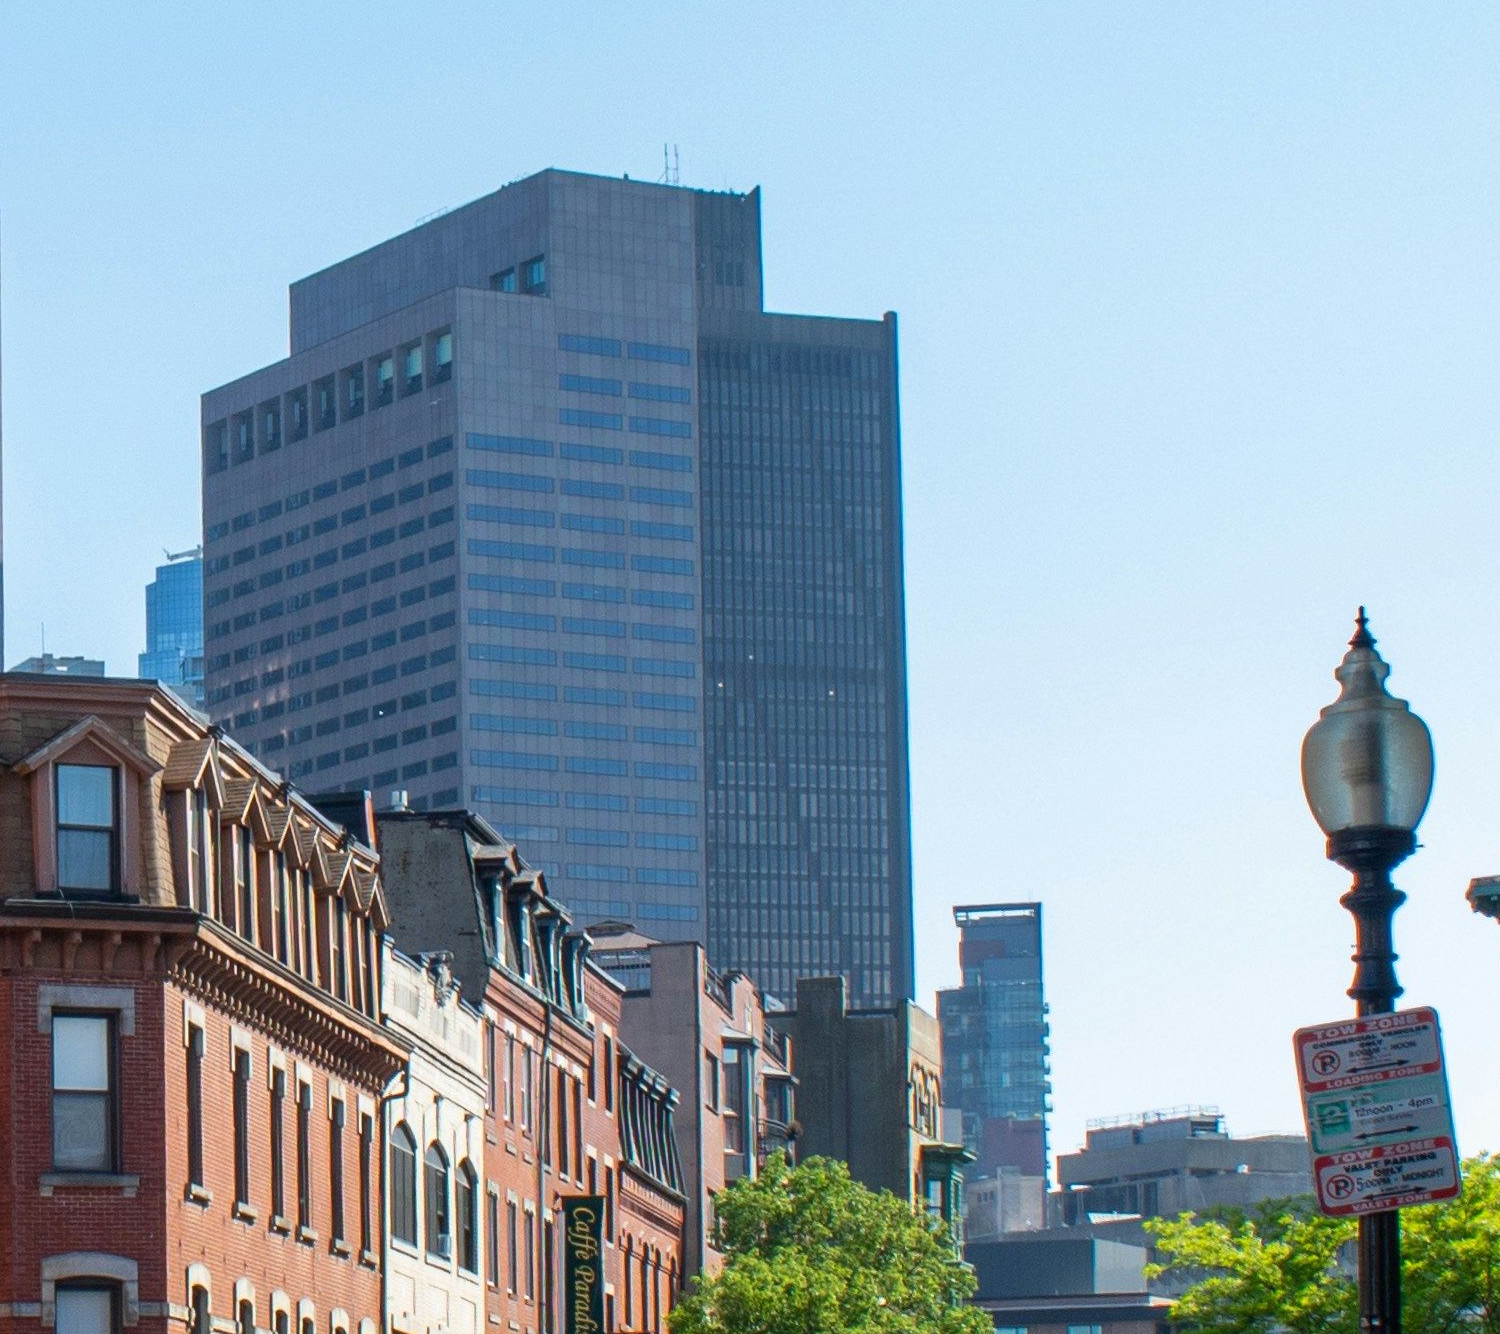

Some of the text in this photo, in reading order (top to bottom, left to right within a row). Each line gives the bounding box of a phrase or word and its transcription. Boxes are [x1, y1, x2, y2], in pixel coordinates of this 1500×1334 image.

[1313, 1014, 1419, 1038] TOW ZONE
[1326, 1066, 1425, 1088] LOADING ZONE
[1331, 1140, 1437, 1164] TOW ZONE
[1343, 1159, 1380, 1173] VALET
[1351, 1193, 1432, 1213] VALET ZONE
